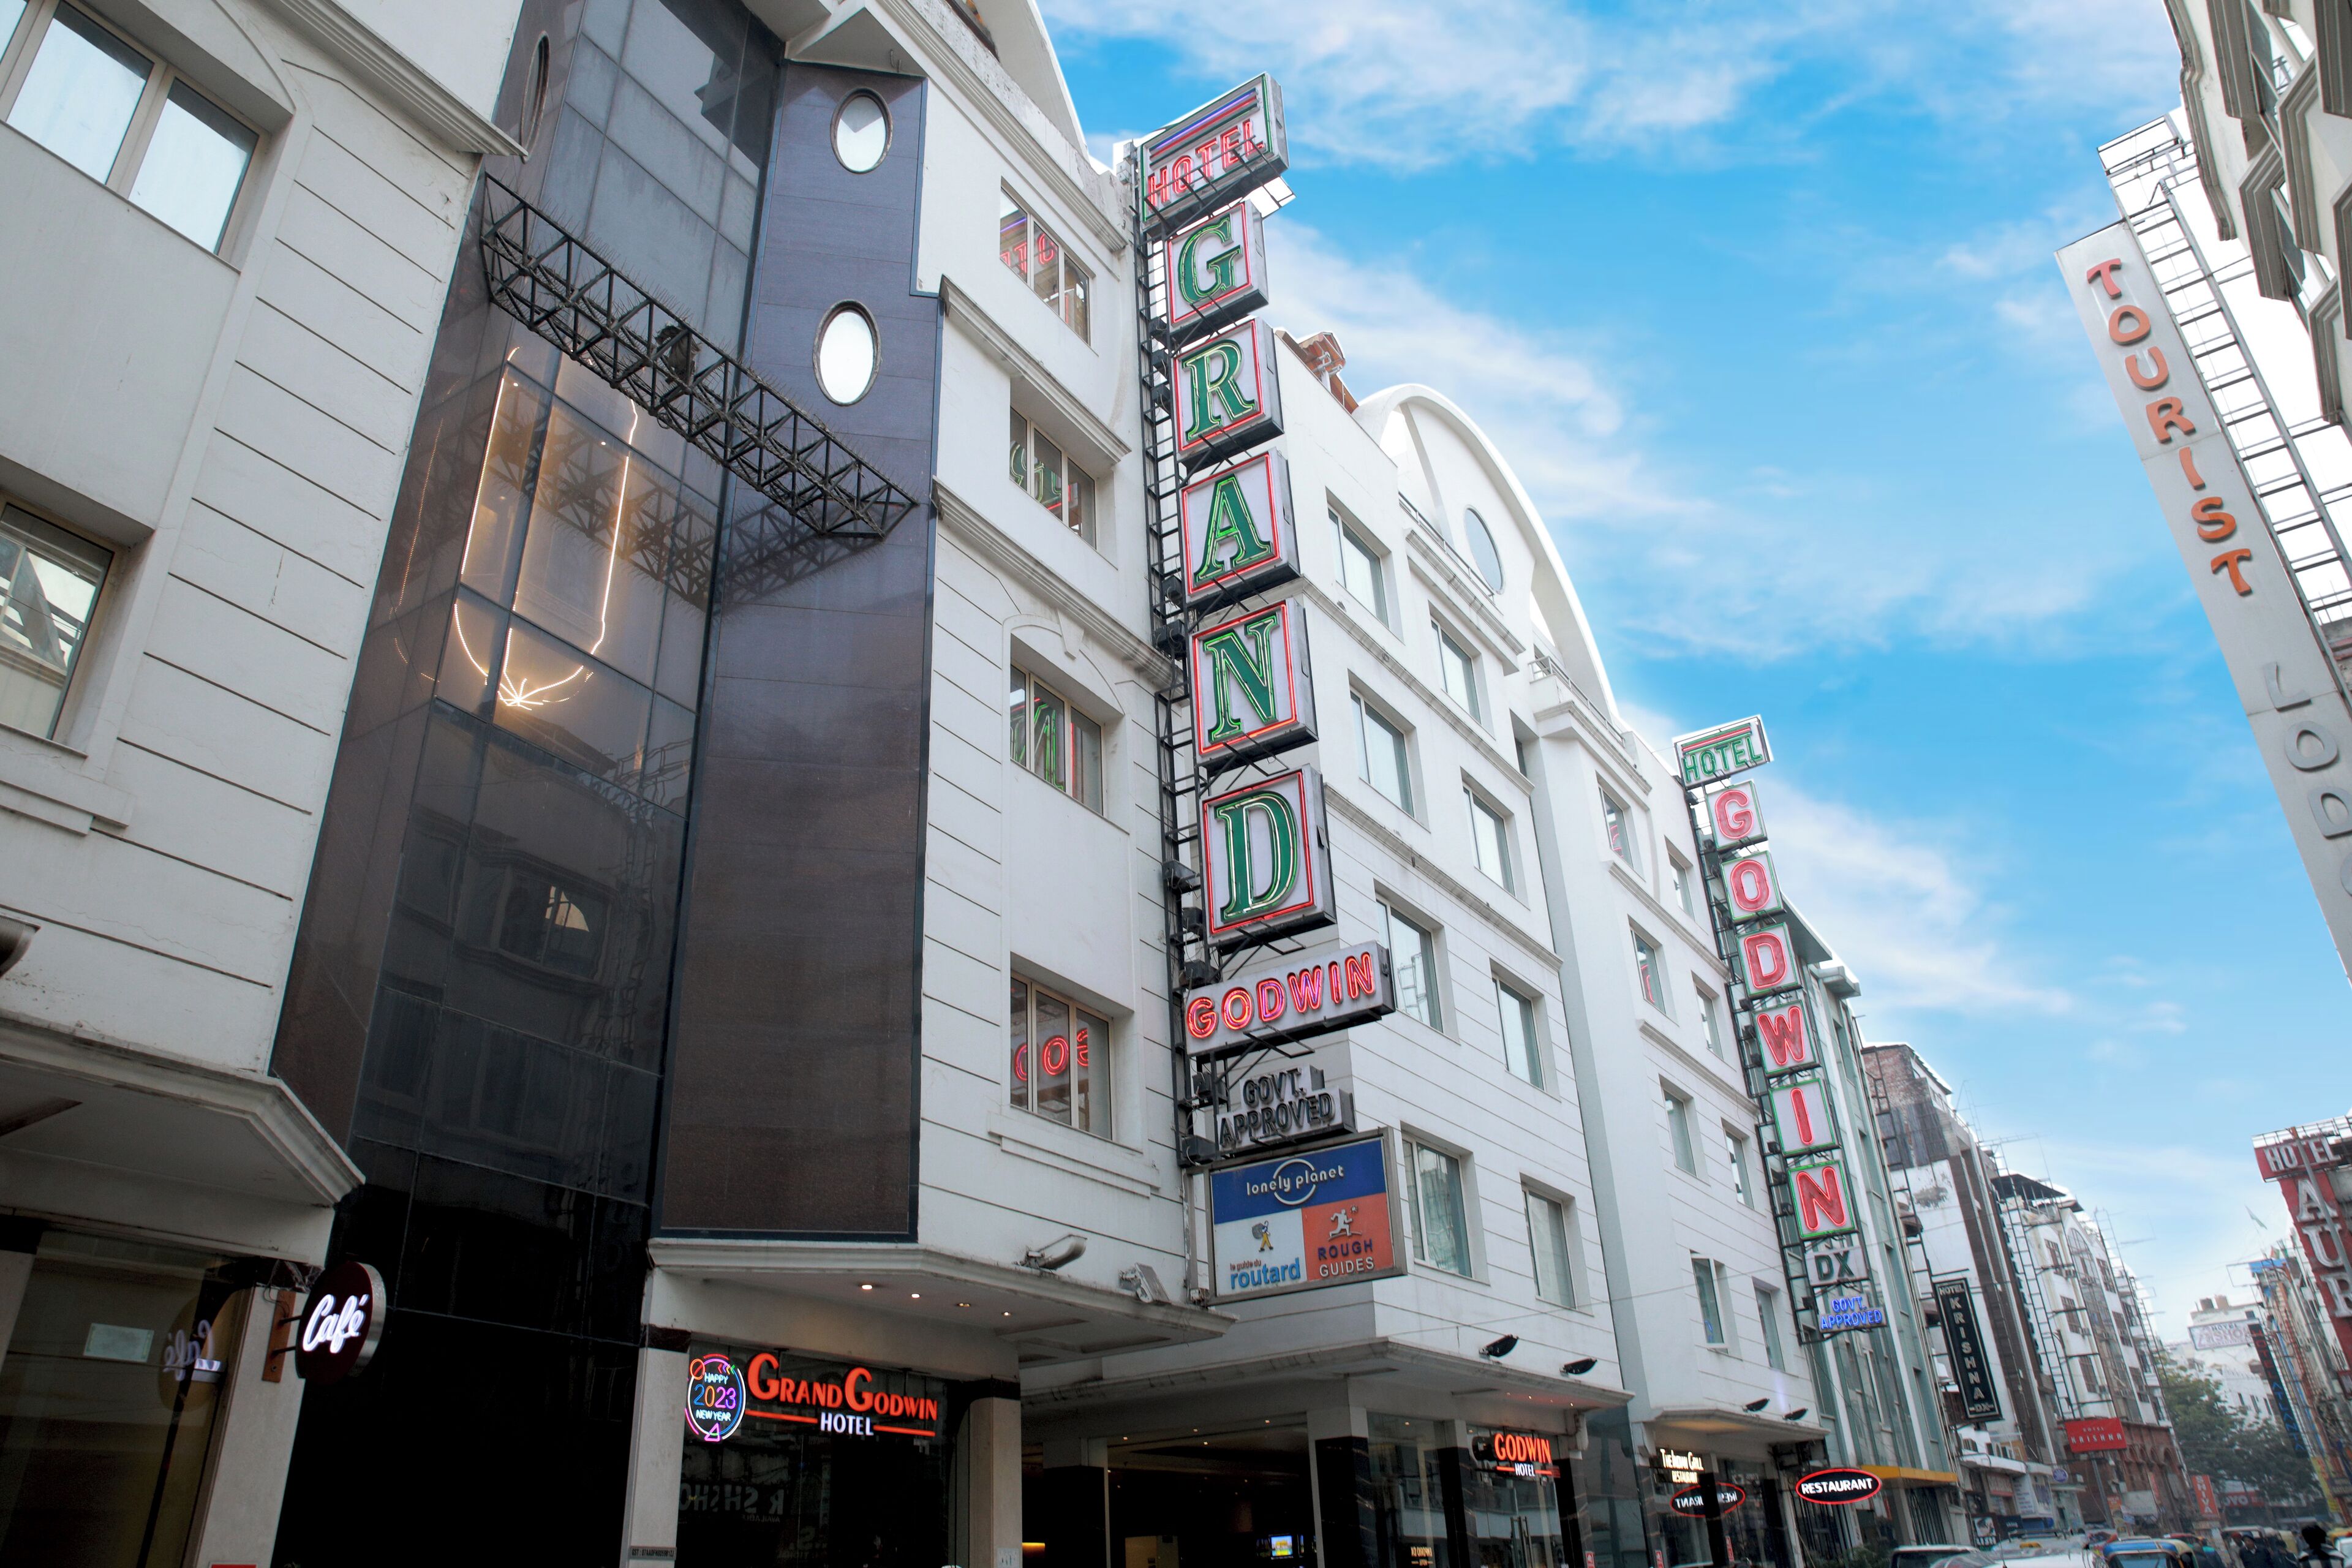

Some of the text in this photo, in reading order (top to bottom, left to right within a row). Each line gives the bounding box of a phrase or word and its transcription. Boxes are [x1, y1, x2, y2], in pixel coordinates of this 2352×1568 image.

[1148, 119, 1264, 207] HOTEL
[2086, 257, 2252, 597] TOURIST
[1177, 217, 1300, 922] GRAND
[1682, 736, 1763, 783] HOTEL
[2263, 661, 2352, 897] LOD
[1186, 951, 1376, 1038] GODWIN
[1714, 789, 1847, 1232] GODWIN
[1243, 1066, 1307, 1107] GOVT.
[1219, 1092, 1335, 1147] APPROVED
[2264, 1136, 2342, 1172] HOEL
[1246, 1165, 1345, 1196] lonely planet
[1230, 1262, 1236, 1270] le
[1236, 1260, 1254, 1270] guide
[1317, 1238, 1373, 1261] ROUGH
[1814, 1250, 1855, 1281] DX
[1231, 1257, 1301, 1289] routard
[1319, 1256, 1375, 1278] GUIDES
[1831, 1295, 1867, 1313] GOVT.
[1939, 1284, 1965, 1296] HOTEL
[303, 1294, 370, 1354] Café
[1820, 1307, 1883, 1330] APPROVED
[1950, 1296, 1985, 1400] KRISHNA
[704, 1371, 729, 1385] HAPPY
[747, 1352, 938, 1421] GRAND GODWIN
[693, 1384, 736, 1409] 2023
[696, 1409, 731, 1422] NEW YEAR
[820, 1411, 875, 1436] HOTEL
[1494, 1432, 1552, 1464] GODWIN
[1515, 1463, 1536, 1478] HOTEL
[1800, 1477, 1874, 1495] RESTAURANT
